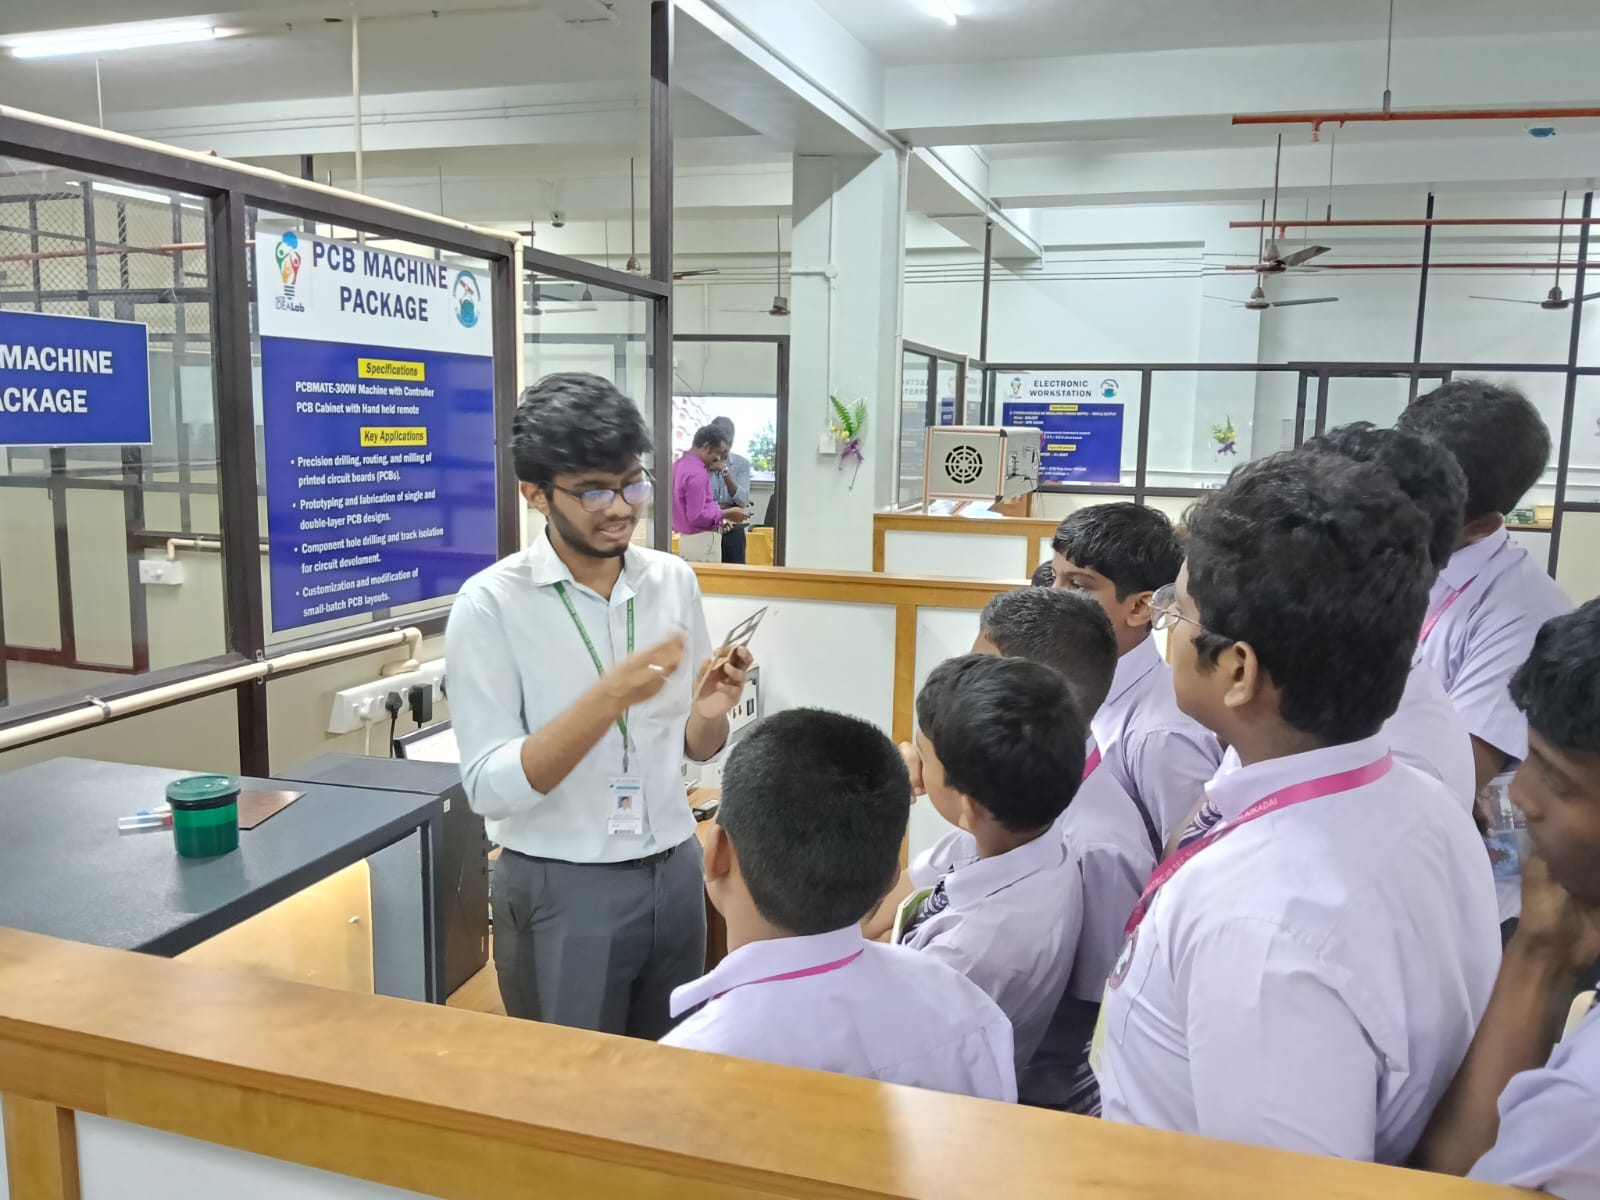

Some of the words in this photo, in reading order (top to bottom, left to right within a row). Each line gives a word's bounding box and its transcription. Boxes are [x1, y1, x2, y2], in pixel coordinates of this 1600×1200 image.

[312, 241, 356, 273] PCB
[363, 250, 449, 290] MACHINE
[340, 286, 429, 322] PACKAGE
[0, 344, 114, 375] MACHINE
[366, 362, 418, 377] Specifications
[295, 381, 358, 395] PCBMATE-300W
[358, 384, 388, 396] Machine
[388, 386, 403, 397] with
[403, 386, 435, 398] Controller
[1029, 389, 1092, 398] WORKSTATION
[1033, 380, 1089, 388] ELECTRONIC
[296, 402, 314, 413] PCB
[314, 402, 345, 414] Cabinet
[345, 403, 361, 414] with
[362, 403, 380, 414] Hand
[381, 404, 396, 415] held
[396, 405, 420, 415] remote
[364, 430, 378, 444] Key
[380, 430, 424, 444] Applications
[297, 455, 334, 468] Precision
[334, 454, 362, 468] drilling,
[362, 453, 389, 466] routing,
[390, 453, 402, 464] and
[403, 452, 425, 465] milling
[425, 452, 432, 462] of
[298, 474, 326, 489] printed
[326, 472, 351, 485] circuit
[351, 471, 376, 484] boards
[376, 470, 401, 484] (PCBs).
[300, 496, 344, 511] Prototyping
[344, 495, 359, 507] and
[359, 492, 396, 506] fabrication
[396, 491, 404, 502] of
[404, 490, 423, 503] single
[424, 489, 436, 500] and
[300, 516, 346, 531] double-layer
[346, 513, 362, 526] PCB
[362, 511, 392, 525] designs.
[301, 541, 345, 555] Component
[345, 537, 362, 549] hole
[362, 533, 387, 547] drilling
[387, 530, 400, 542] and
[400, 529, 418, 541] track
[418, 527, 444, 539] isolation
[301, 562, 313, 574] for
[313, 558, 339, 572] circuit
[302, 580, 356, 598] Customization
[356, 576, 370, 588] and
[370, 569, 411, 585] modification
[411, 567, 419, 579] of
[303, 599, 347, 617] small-batch
[347, 595, 363, 609] PCB
[364, 592, 391, 607] layouts.
